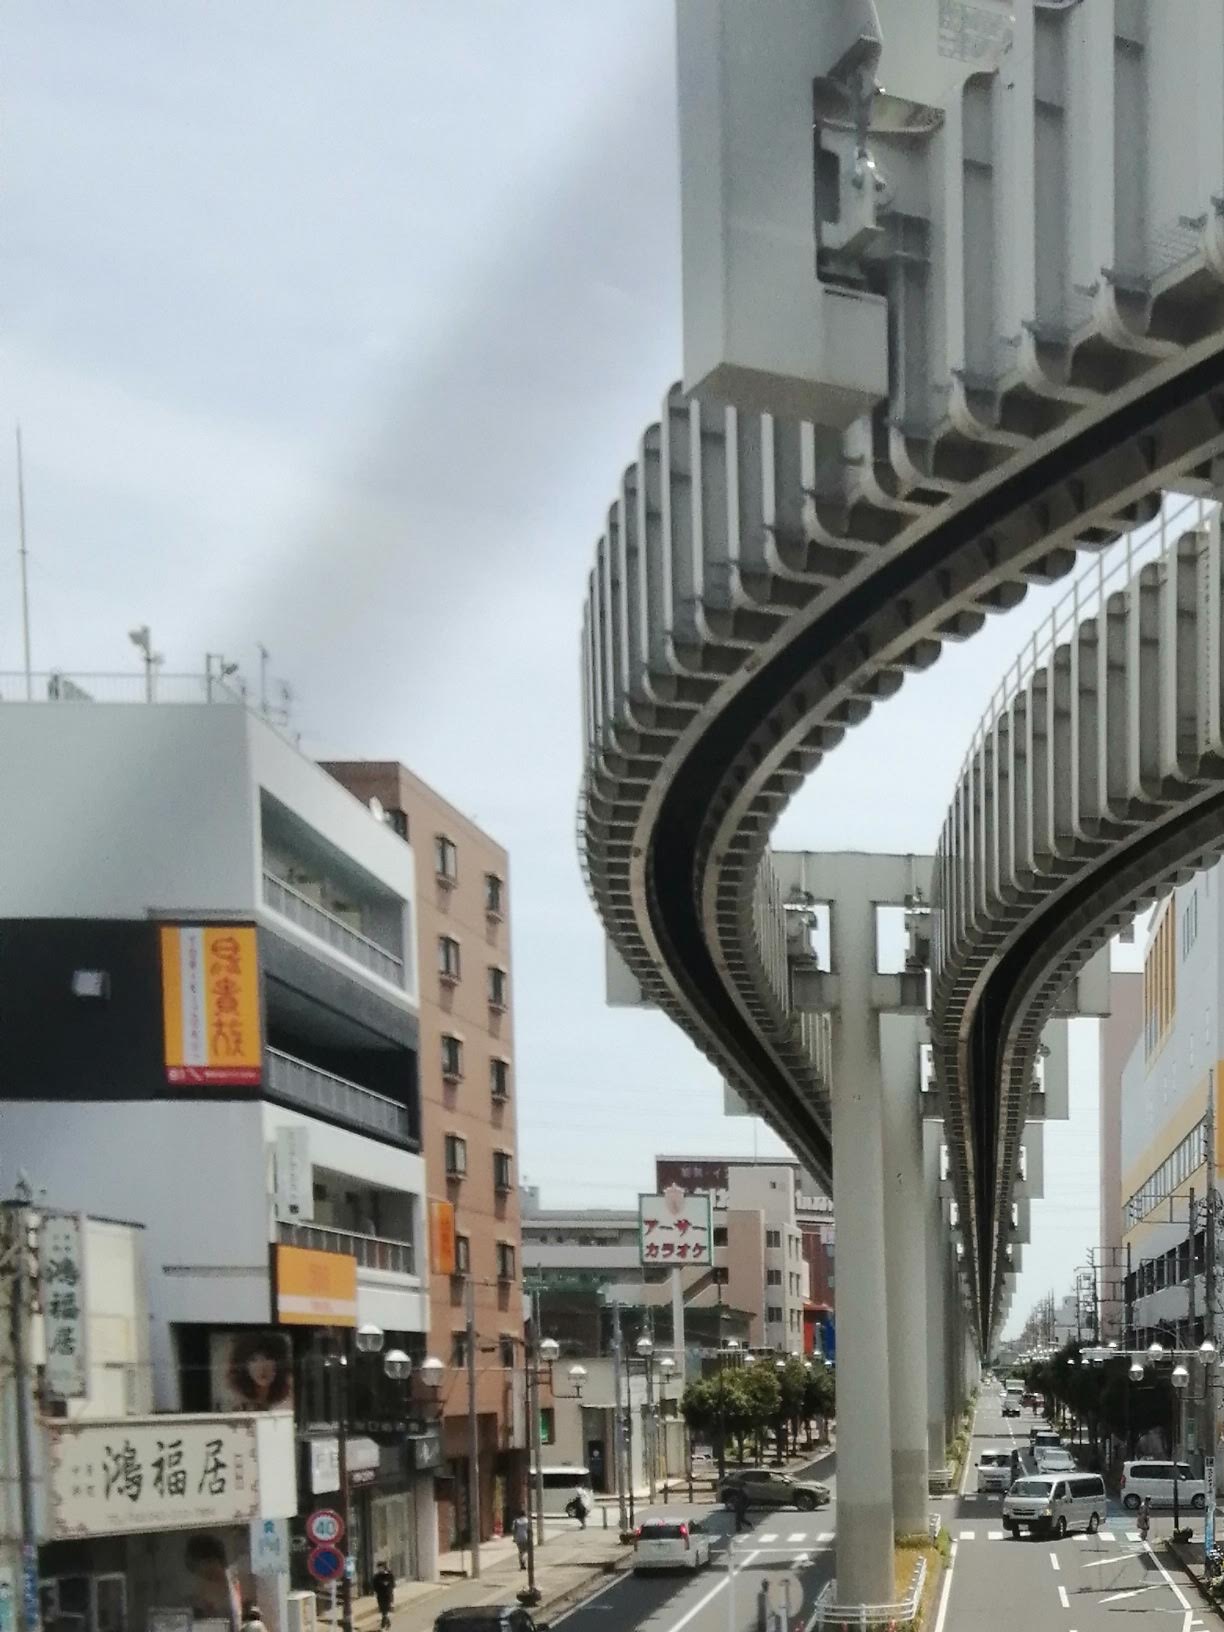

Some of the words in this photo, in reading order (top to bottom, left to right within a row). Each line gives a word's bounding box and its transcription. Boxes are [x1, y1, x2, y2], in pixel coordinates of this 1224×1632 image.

[644, 1219, 707, 1237] アーサー
[645, 1242, 707, 1259] カラオケ
[103, 1440, 227, 1502] 鴻福居
[316, 1521, 336, 1535] 40
